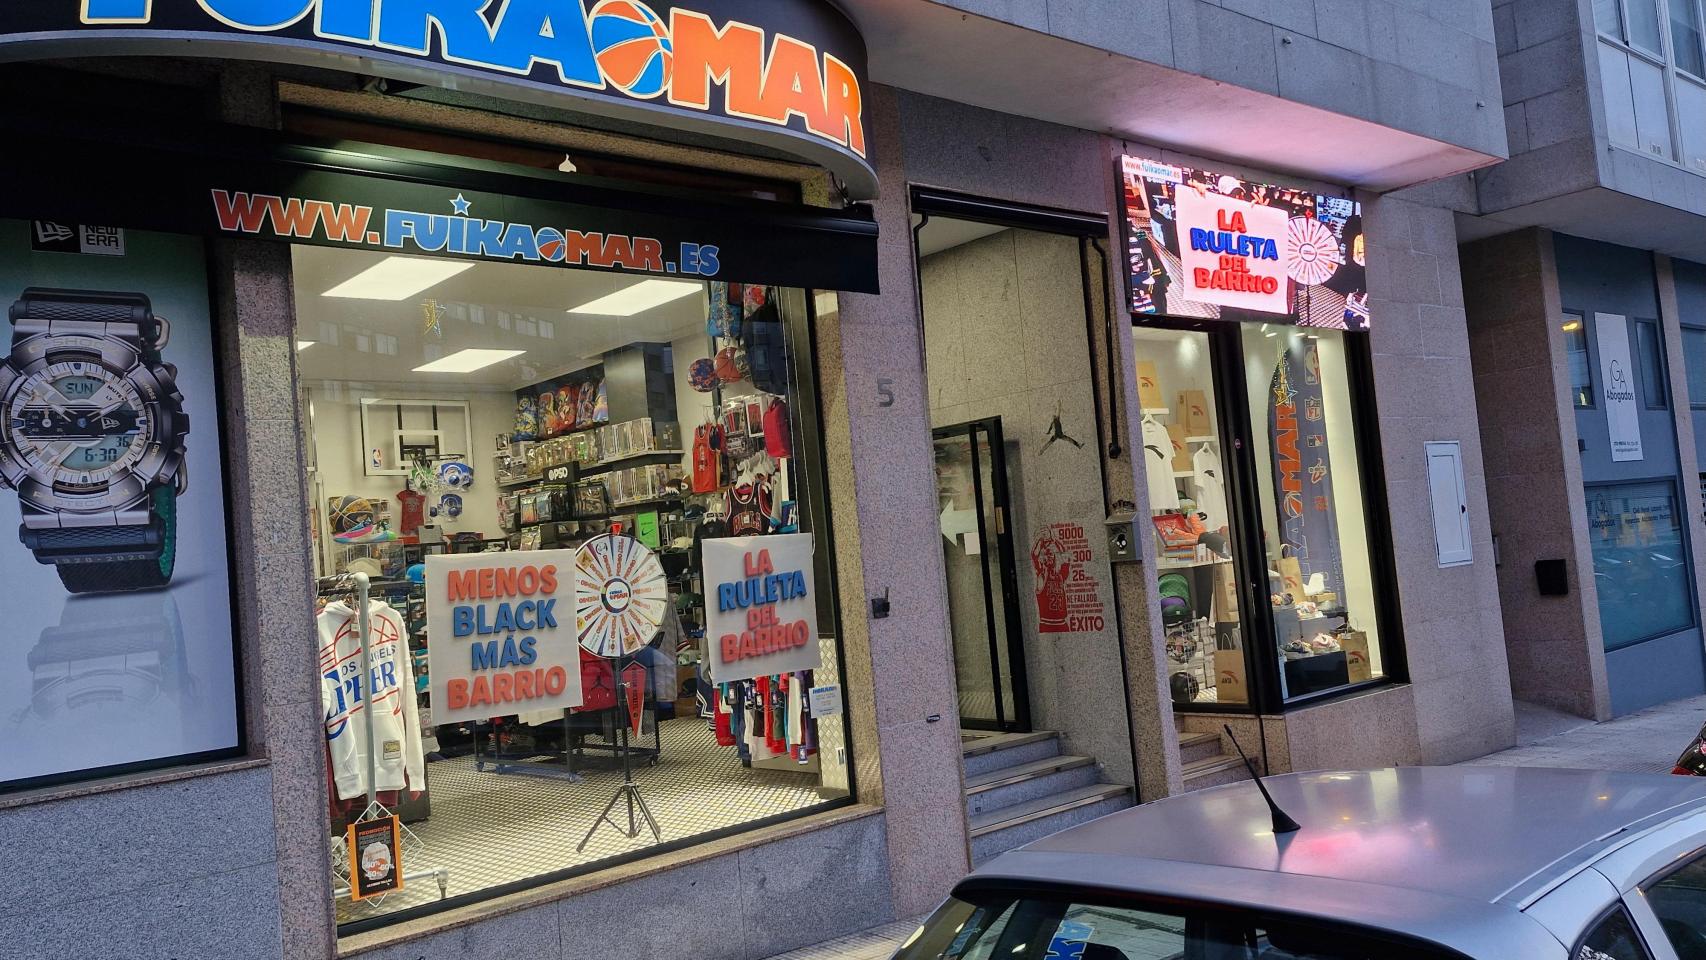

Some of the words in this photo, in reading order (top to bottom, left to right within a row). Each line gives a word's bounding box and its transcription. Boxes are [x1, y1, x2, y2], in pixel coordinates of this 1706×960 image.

[80, 0, 867, 158] KAOMAR
[1217, 208, 1247, 233] LA
[86, 234, 119, 248] ERA
[1190, 227, 1279, 260] RULETA
[1219, 255, 1250, 272] DEL
[1194, 267, 1278, 295] BARRIO
[65, 382, 93, 394] SUN
[877, 378, 895, 407] 5
[1606, 389, 1634, 403] Abogados
[1058, 527, 1084, 540] 9000
[744, 549, 773, 576] LA
[1072, 549, 1092, 562] 300
[447, 564, 559, 602] MENOS
[1072, 570, 1085, 581] 26
[718, 570, 808, 612] RULETA
[453, 598, 558, 638] BLACK
[747, 605, 780, 631] DEL
[1070, 615, 1105, 632] ÉXITO
[471, 634, 538, 672] MÁS
[721, 618, 810, 664] BARRIO
[447, 665, 567, 710] BARRIO
